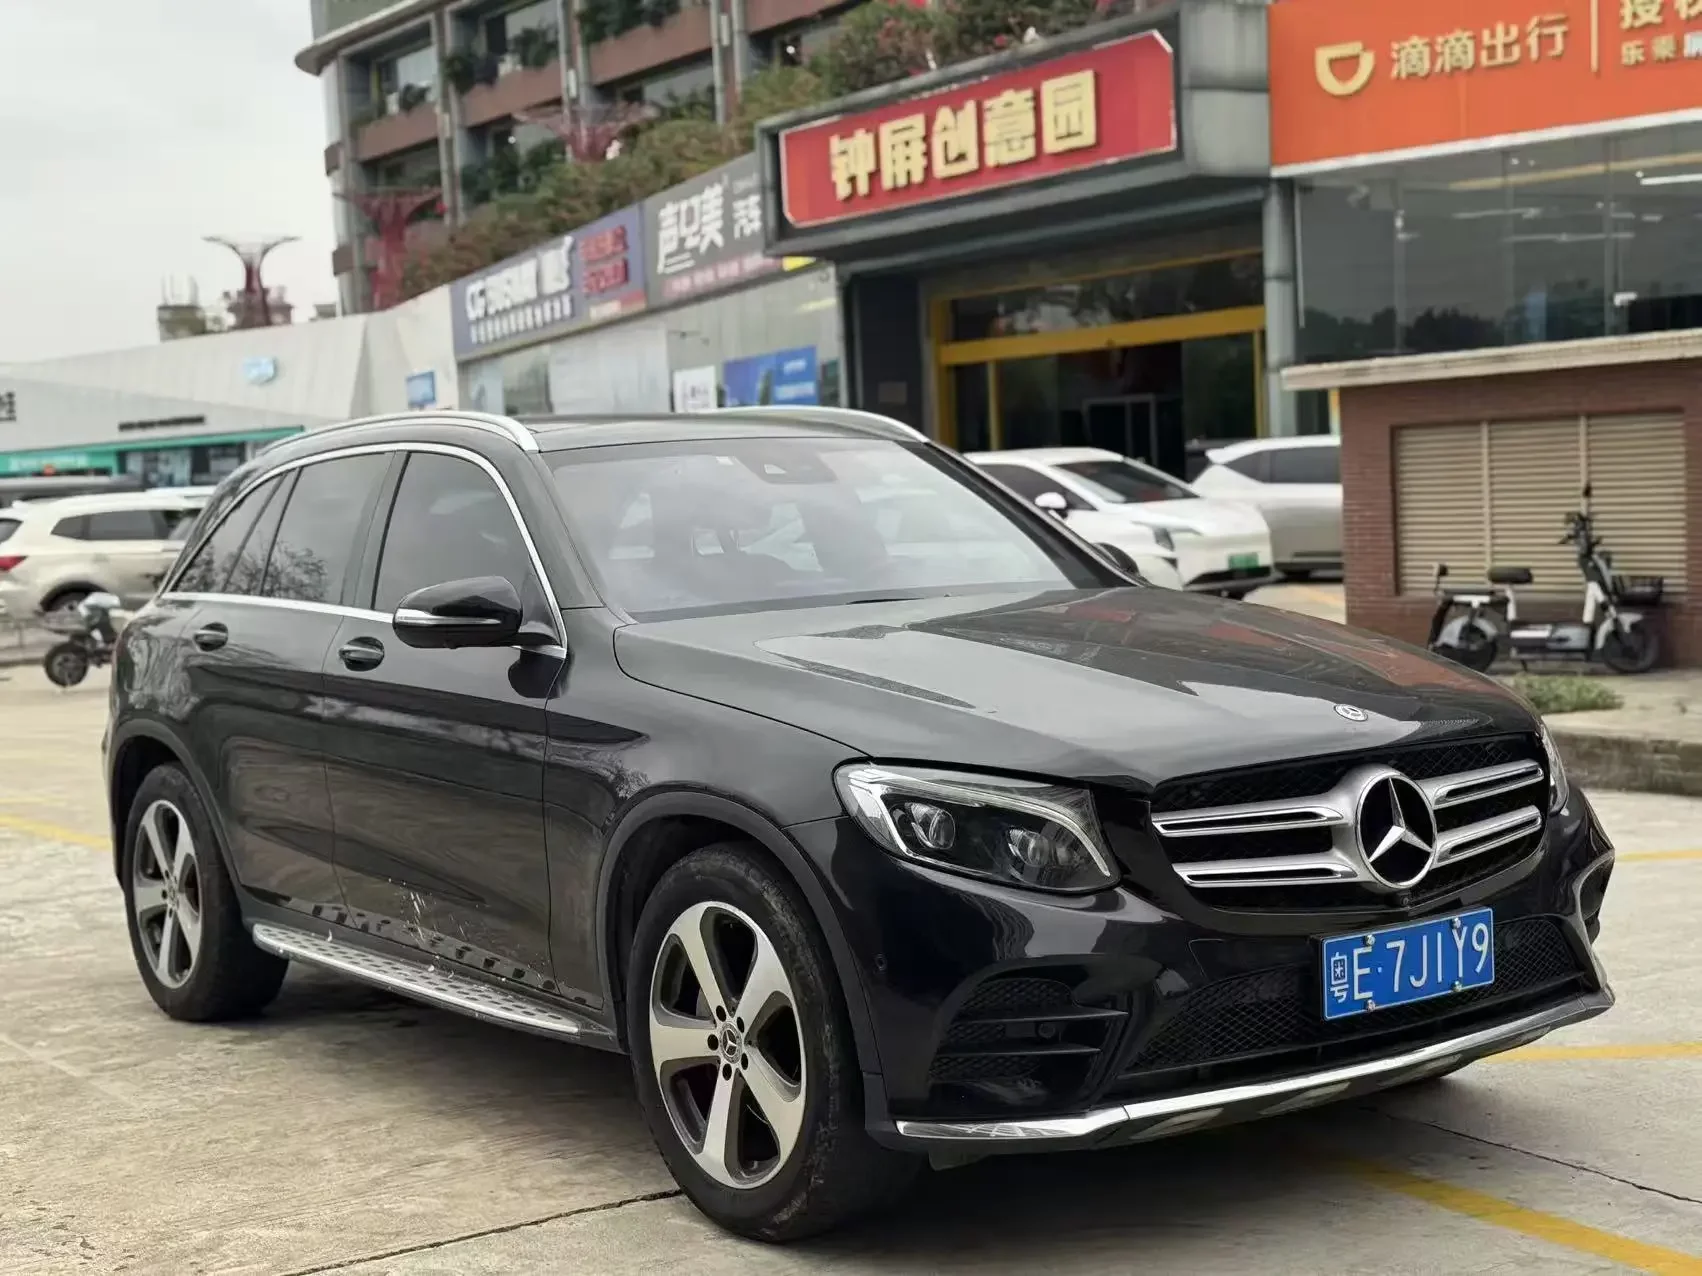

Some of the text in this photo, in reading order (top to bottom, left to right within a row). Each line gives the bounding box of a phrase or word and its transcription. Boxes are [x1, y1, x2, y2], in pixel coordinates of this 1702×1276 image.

[1390, 13, 1568, 79] 滴滴出行
[829, 69, 1097, 201] 钟屏创意园
